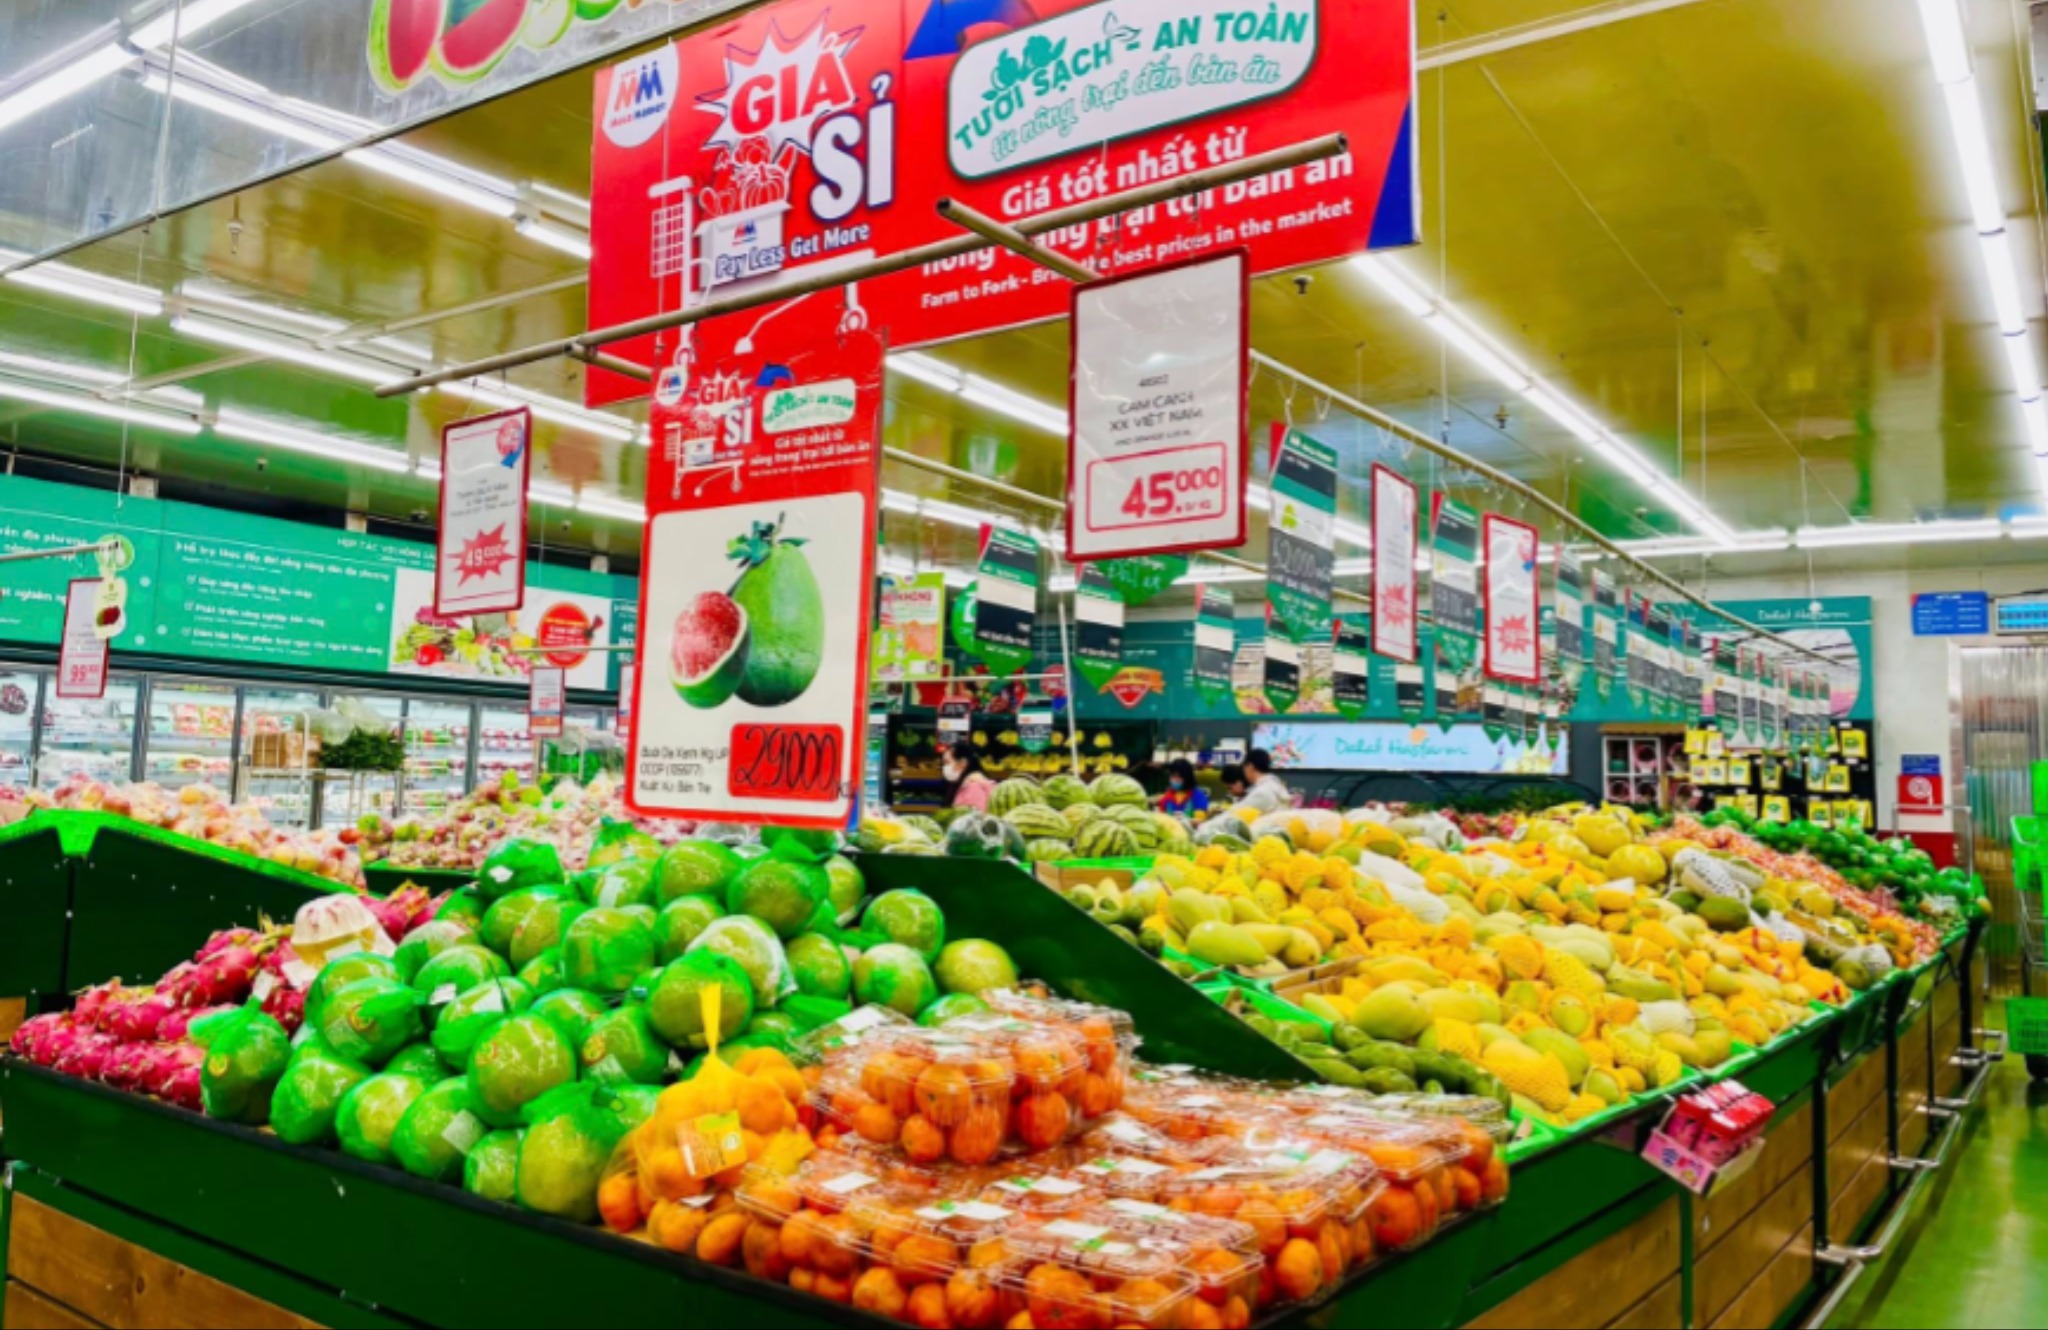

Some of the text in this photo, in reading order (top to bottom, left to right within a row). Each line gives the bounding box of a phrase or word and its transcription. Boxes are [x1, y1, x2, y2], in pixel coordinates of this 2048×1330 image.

[731, 32, 853, 136] GIÁ
[1033, 38, 1112, 97] SẠCH
[1153, 16, 1201, 50] AN
[1214, 2, 1309, 44] TOÀN
[810, 72, 895, 222] SỈ
[1001, 126, 1248, 216] Giá tốt nhất từ
[715, 223, 870, 279] Pay Less Get More
[921, 289, 960, 309] Farm
[963, 284, 980, 300] to
[1114, 242, 1151, 266] best
[1157, 231, 1212, 261] prices
[1216, 222, 1235, 243] in
[1239, 216, 1273, 238] the
[1278, 197, 1353, 230] market
